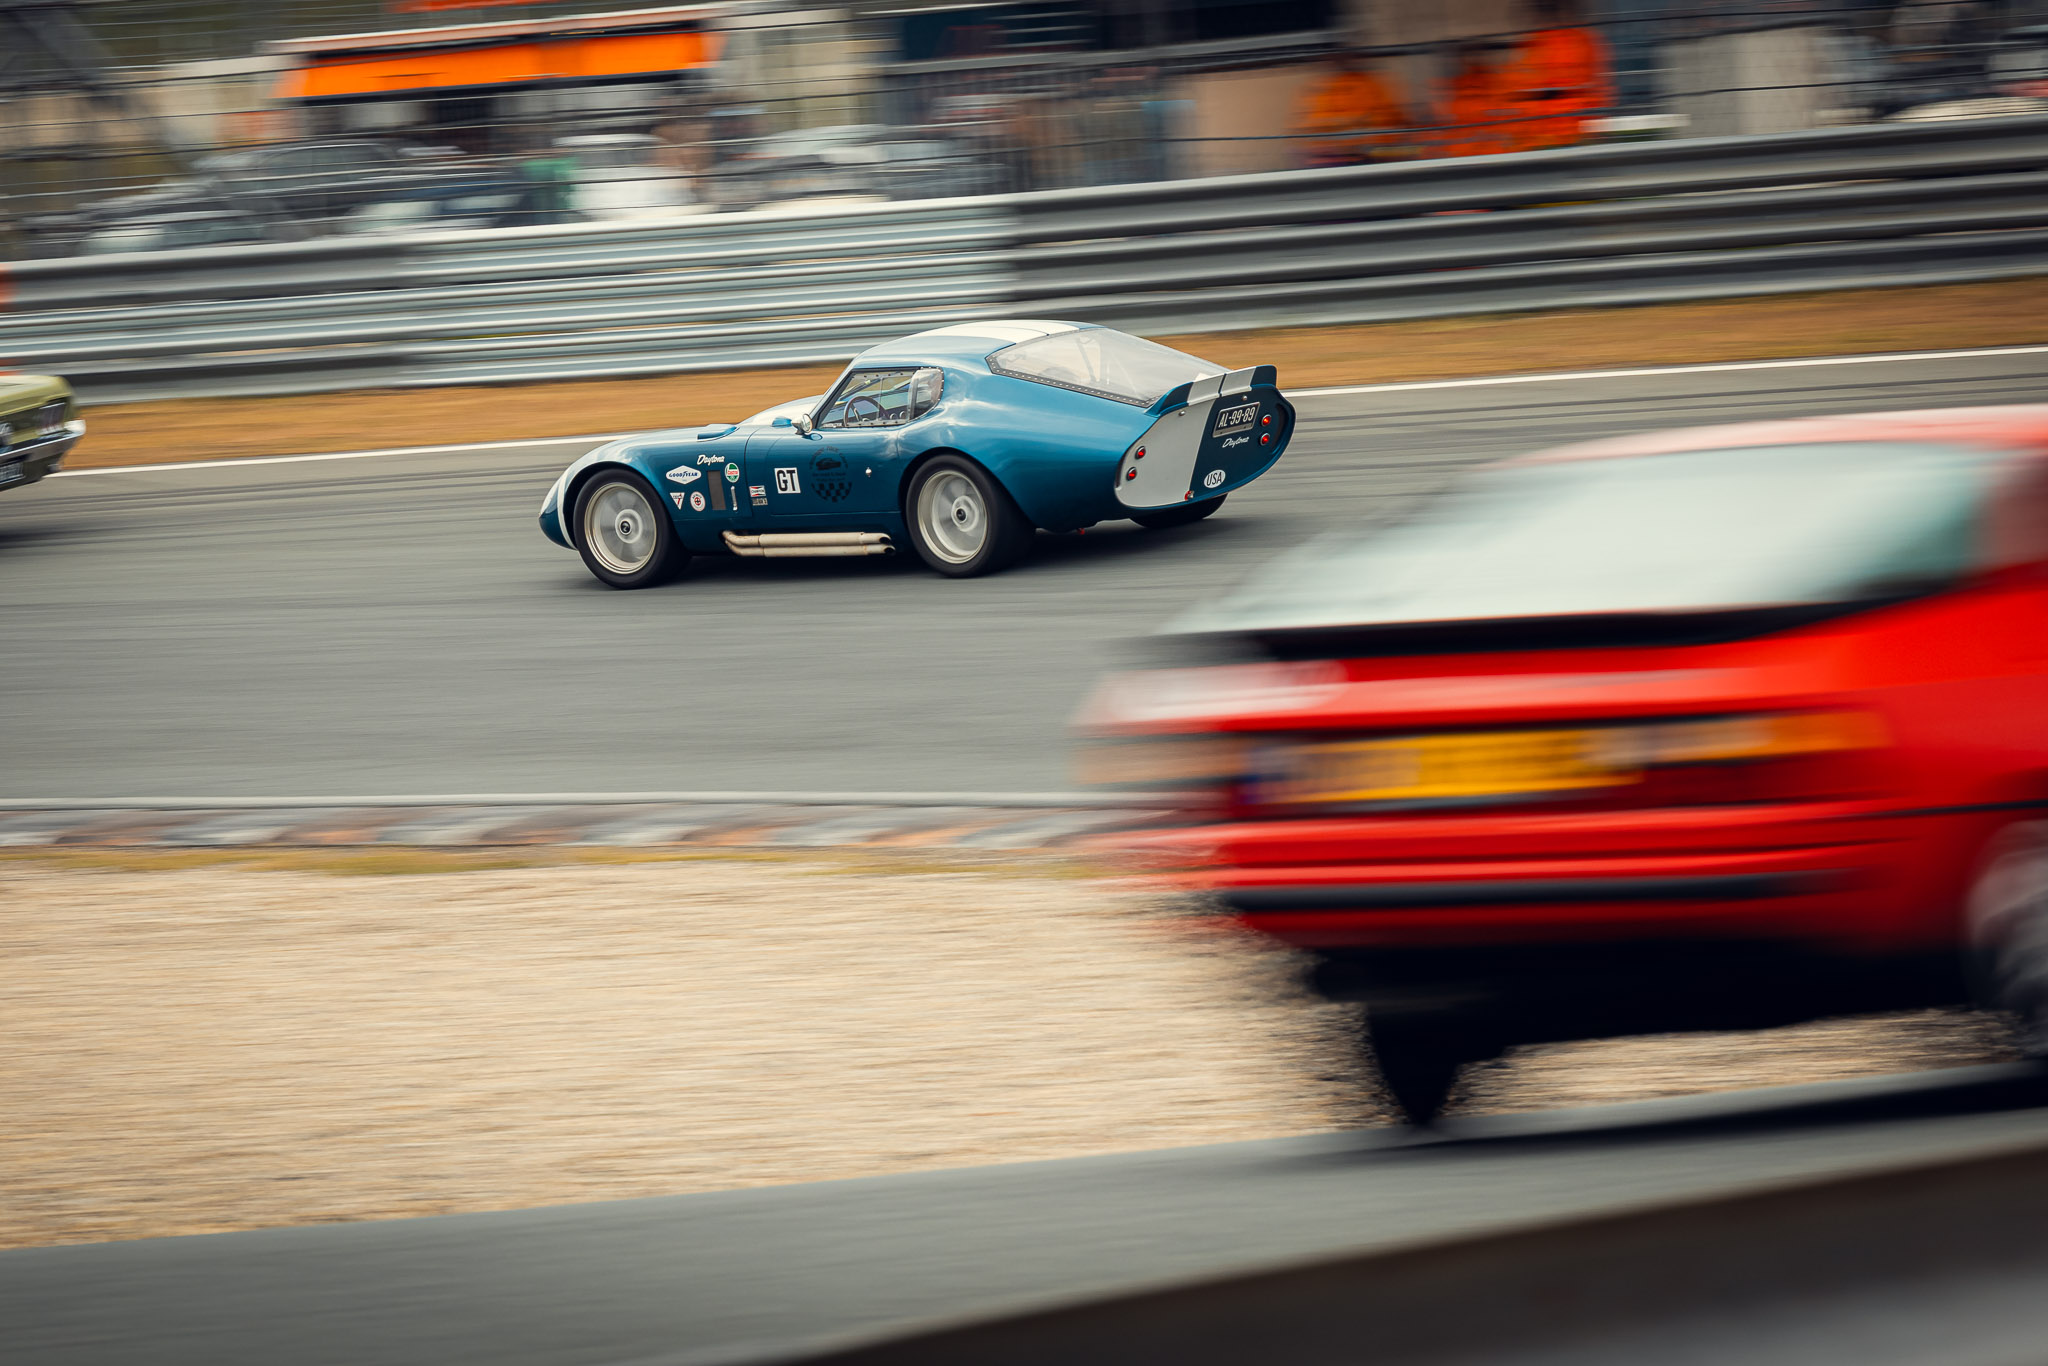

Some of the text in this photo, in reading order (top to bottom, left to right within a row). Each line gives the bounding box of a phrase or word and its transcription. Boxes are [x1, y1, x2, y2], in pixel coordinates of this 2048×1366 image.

[1218, 407, 1256, 428] AL-99-89
[1222, 436, 1250, 448] Daytona
[697, 454, 725, 466] Daytona
[777, 470, 796, 491] GT
[1206, 472, 1222, 486] USA
